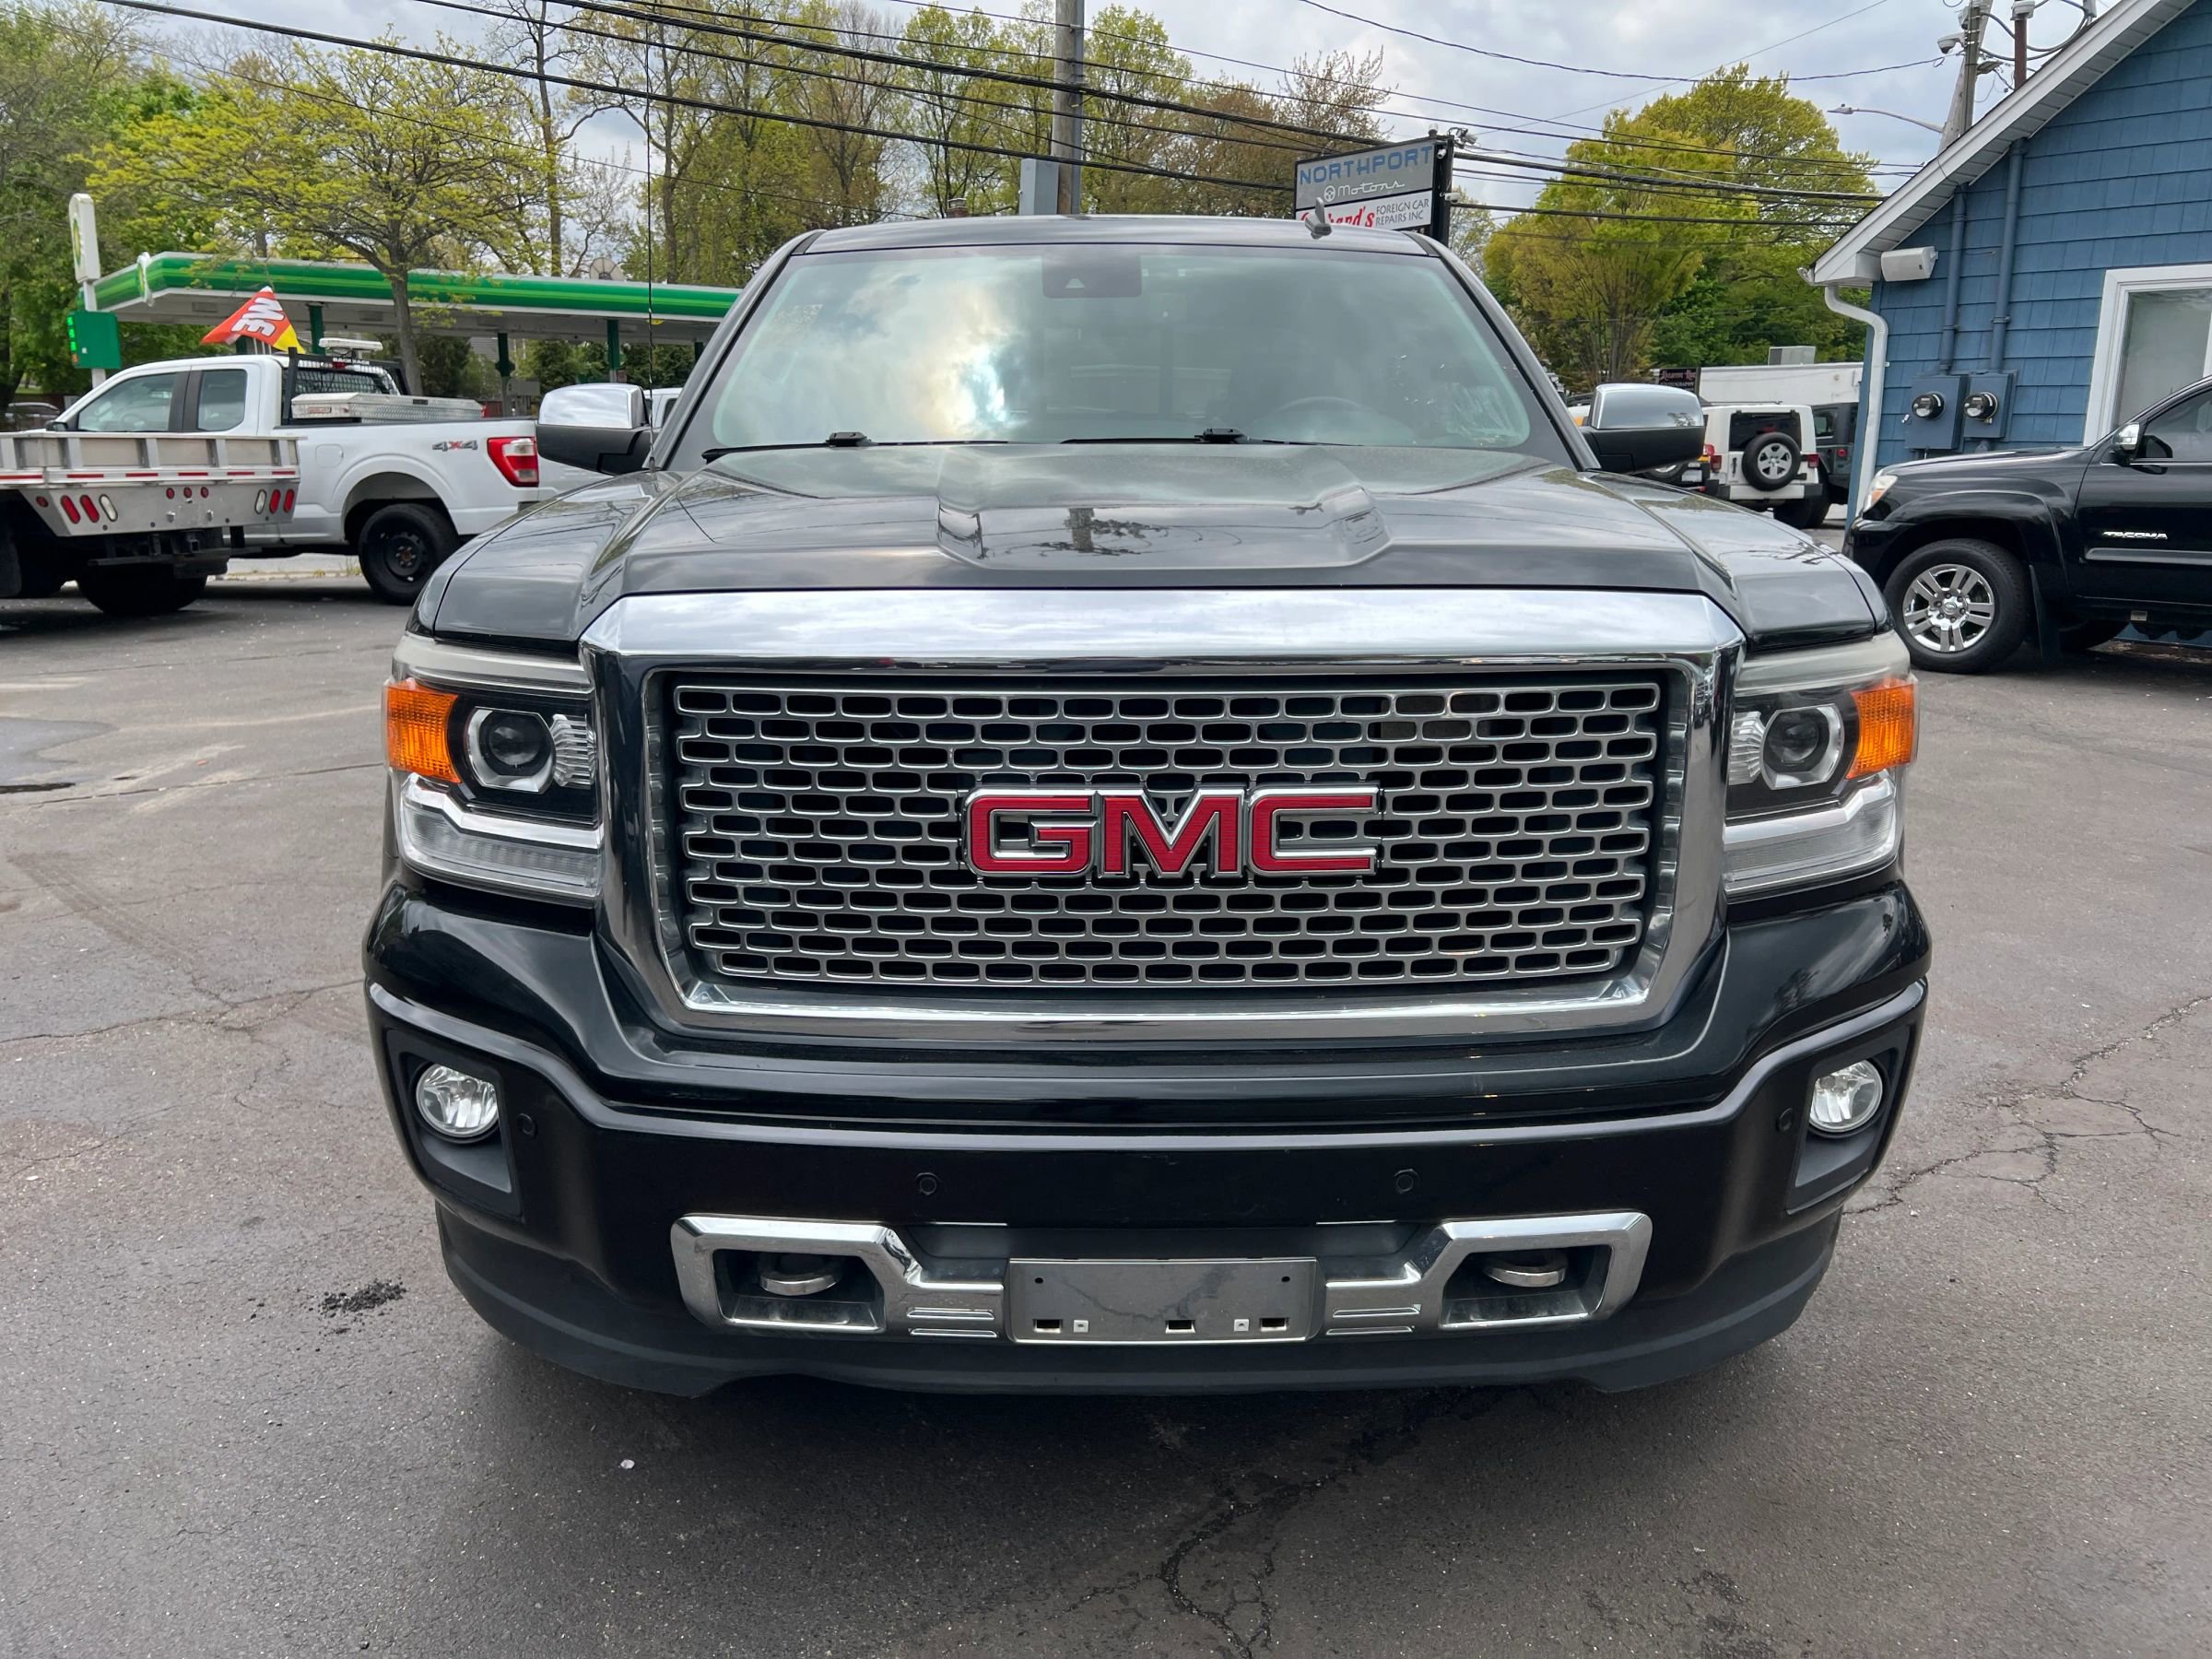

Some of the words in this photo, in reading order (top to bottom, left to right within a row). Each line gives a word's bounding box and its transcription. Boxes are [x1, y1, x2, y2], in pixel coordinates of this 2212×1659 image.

[1300, 146, 1432, 185] NORTHPORT
[1337, 180, 1406, 197] Motors
[1376, 201, 1412, 215] FOREIGN
[1412, 198, 1430, 209] CAR
[1375, 212, 1407, 227] REPAIRS
[1408, 210, 1424, 220] INC
[2102, 531, 2168, 540] TACOMA
[963, 784, 1381, 878] GMC
